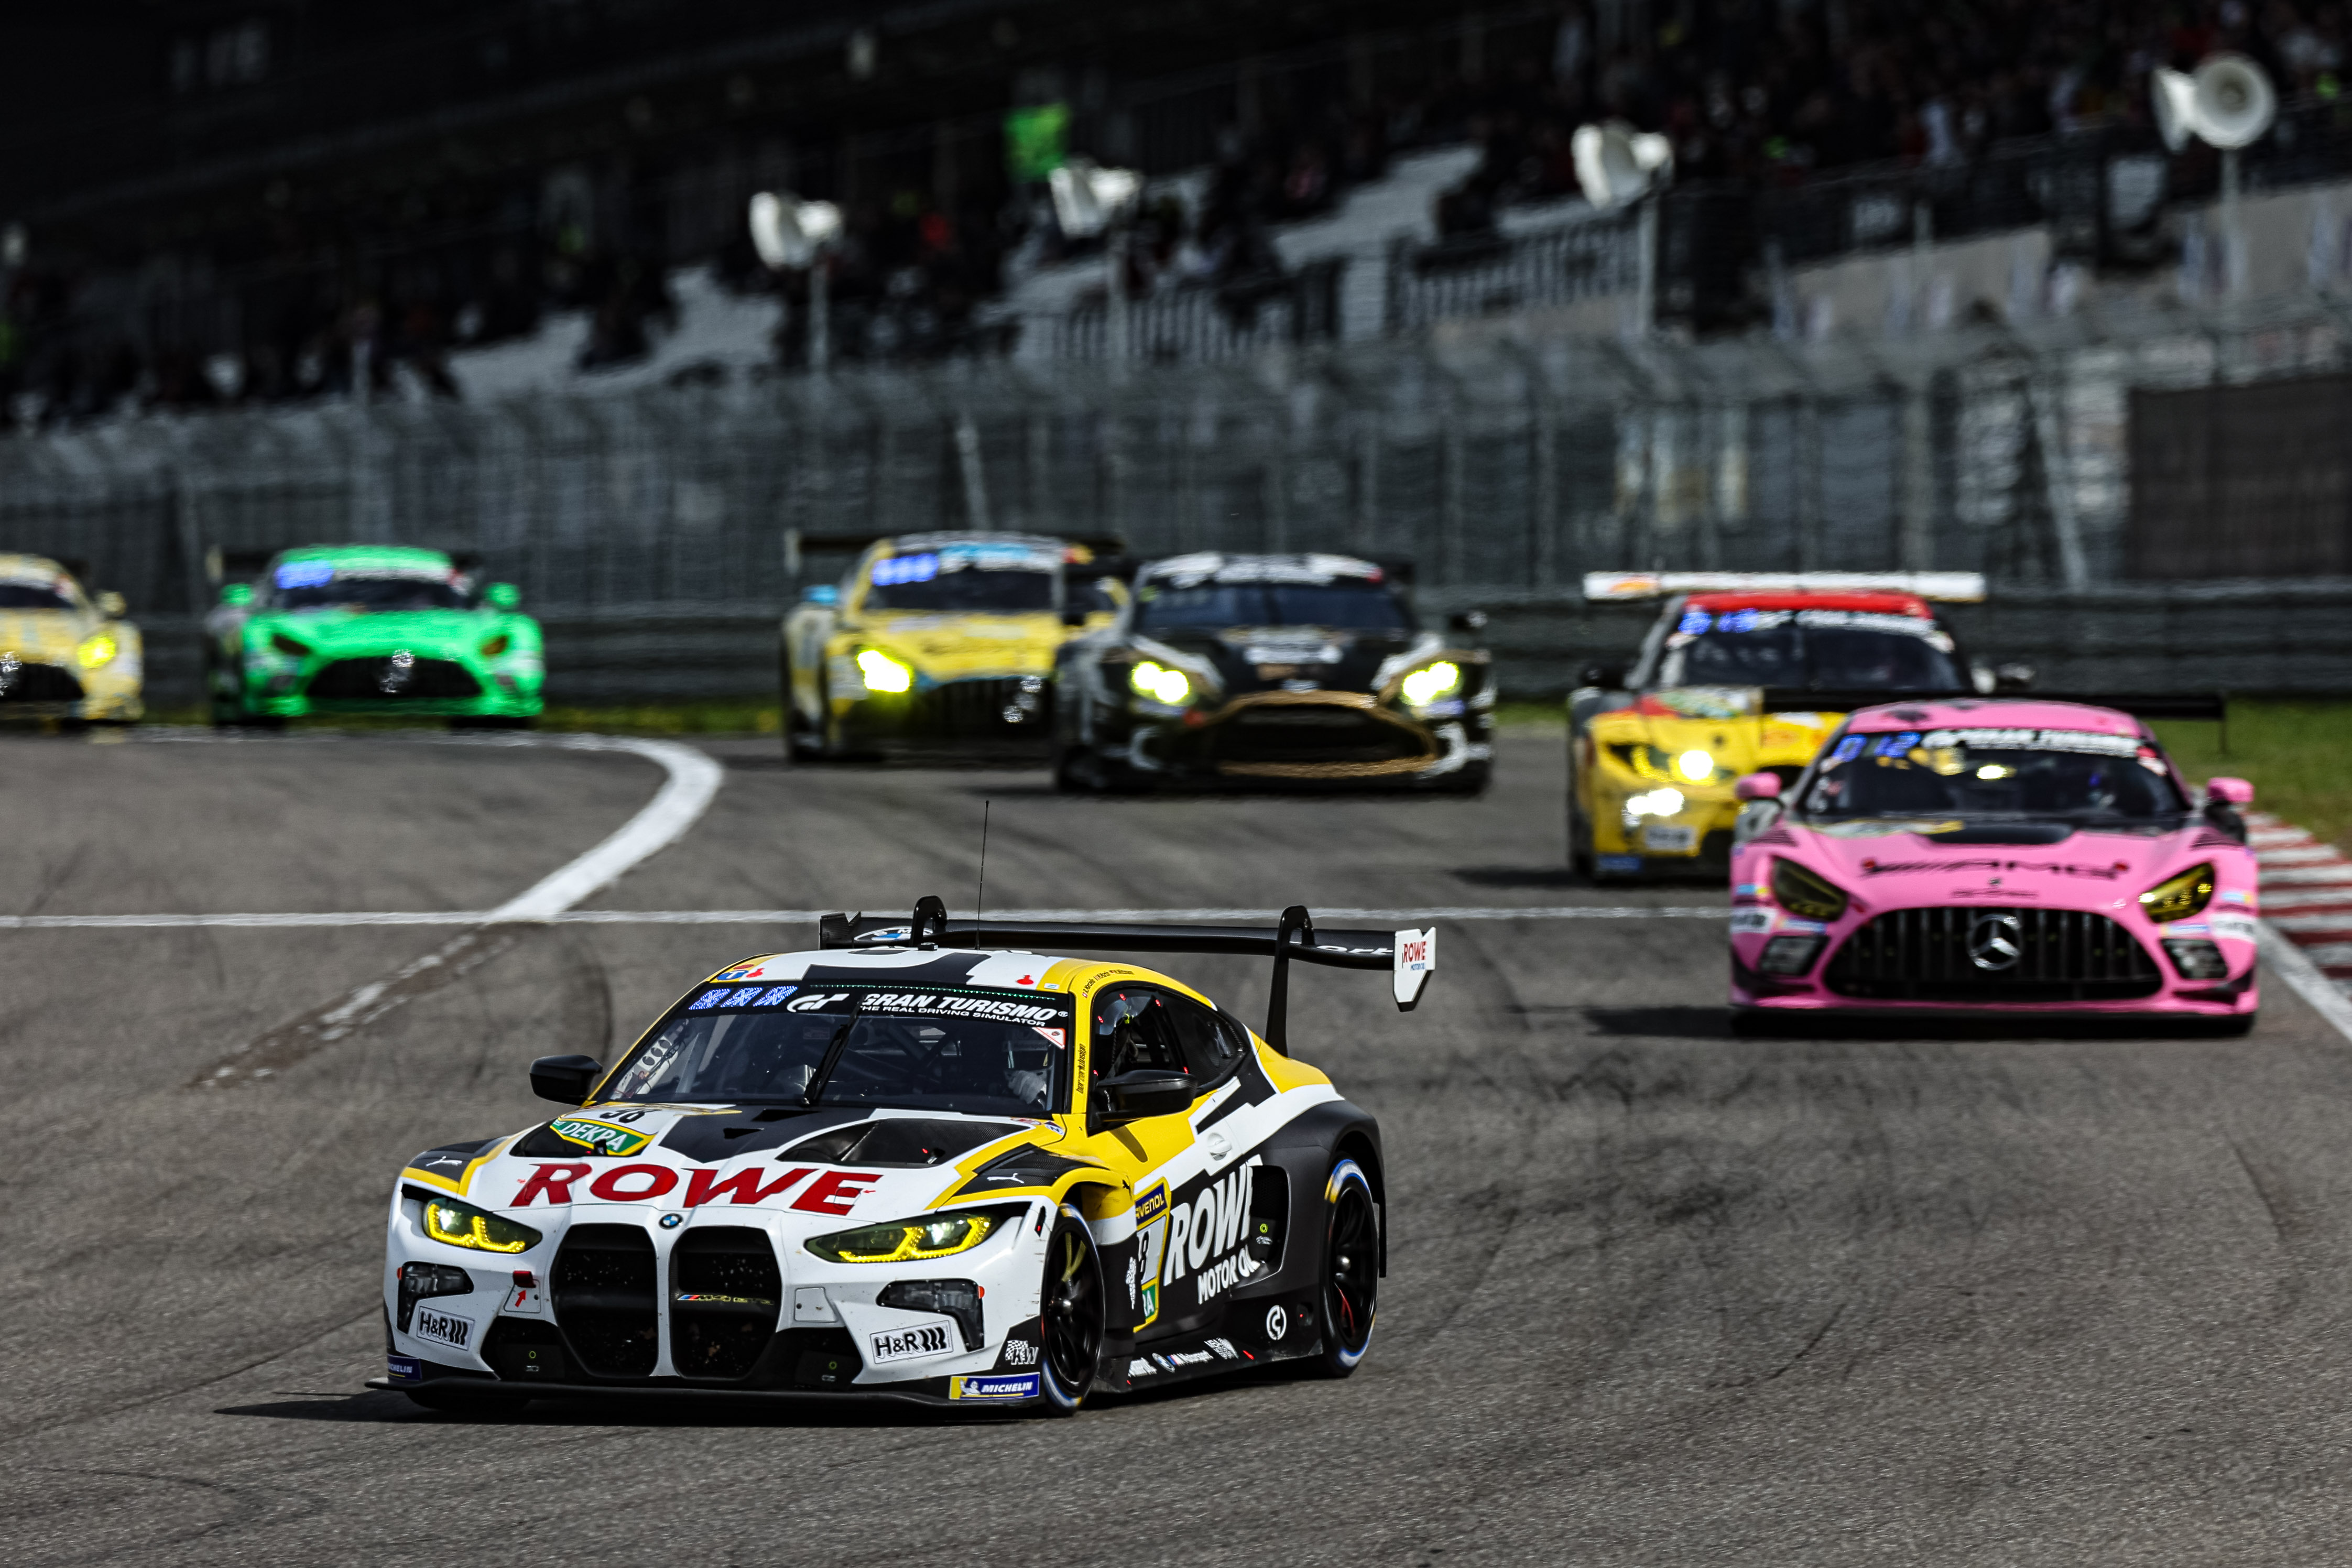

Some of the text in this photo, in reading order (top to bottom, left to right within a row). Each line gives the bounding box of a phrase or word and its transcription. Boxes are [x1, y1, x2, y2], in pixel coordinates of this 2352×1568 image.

[1403, 941, 1426, 963] ROWE
[862, 993, 1057, 1021] GRAN TURISMO
[918, 1007, 970, 1017] DRIVING
[973, 1012, 1046, 1027] SIMULATOR
[559, 1122, 627, 1151] DEKRA
[510, 1163, 884, 1216] ROWE
[1136, 1193, 1164, 1219] AVENOL
[1197, 1255, 1239, 1305] MOTOR
[388, 1362, 412, 1373] ICHELIN
[1011, 1346, 1039, 1365] KW
[981, 1381, 1033, 1393] MICHELIN
